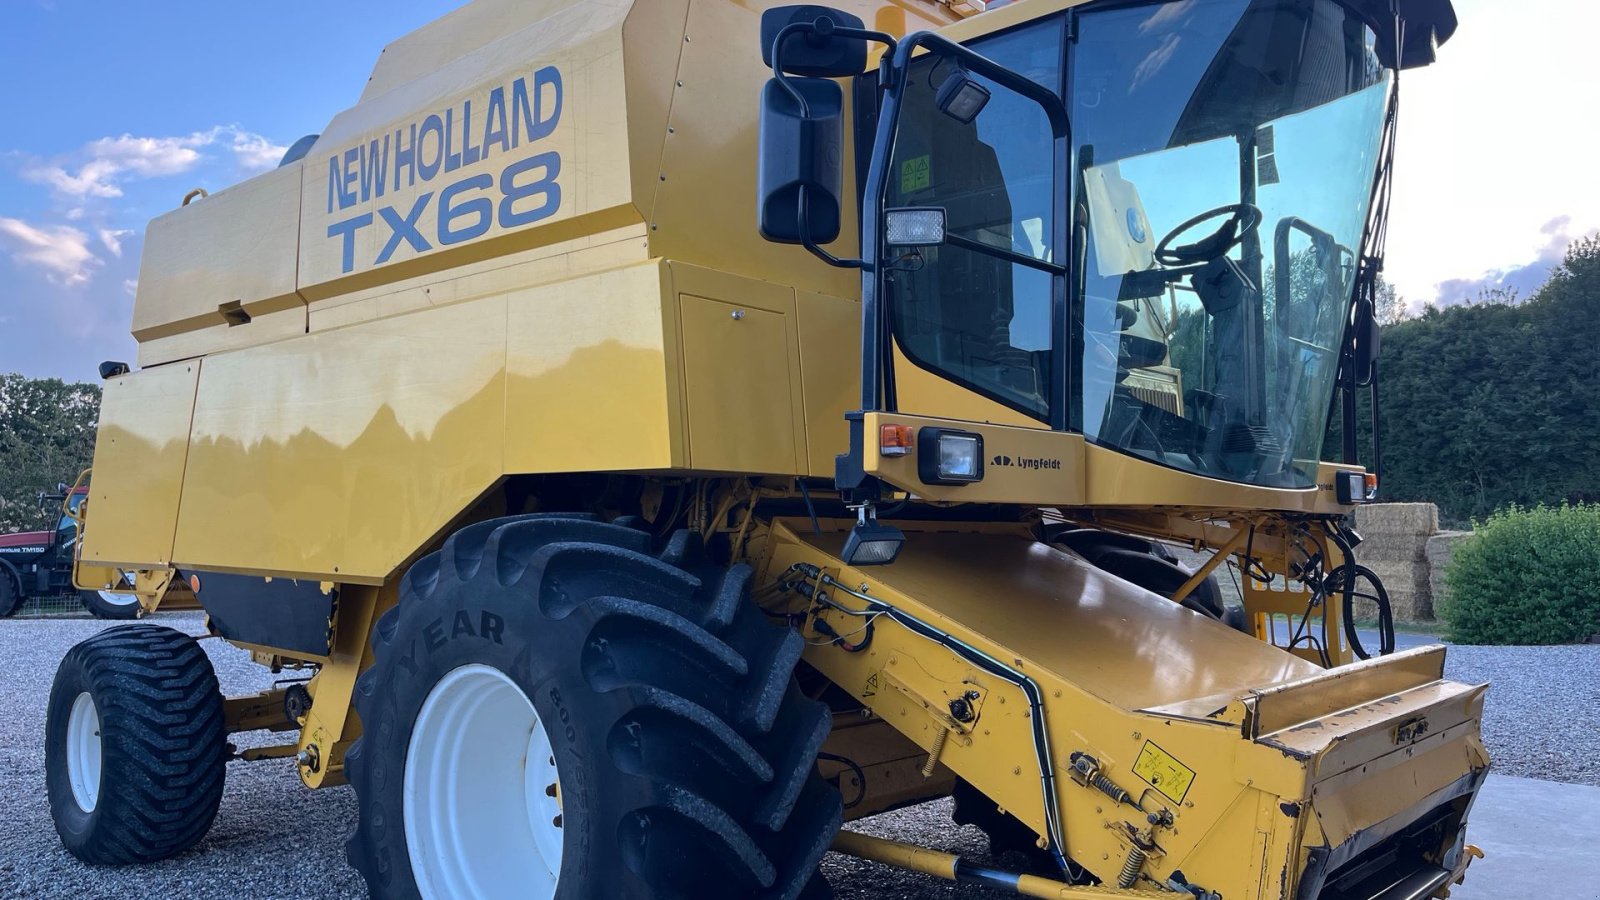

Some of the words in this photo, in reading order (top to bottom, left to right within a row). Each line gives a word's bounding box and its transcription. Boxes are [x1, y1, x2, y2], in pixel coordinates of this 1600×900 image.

[327, 134, 390, 214] NEW
[394, 65, 563, 192] HOLLAND
[327, 150, 562, 274] TX68
[1017, 456, 1061, 470] Lyngfeldt
[399, 609, 505, 678] YEAR
